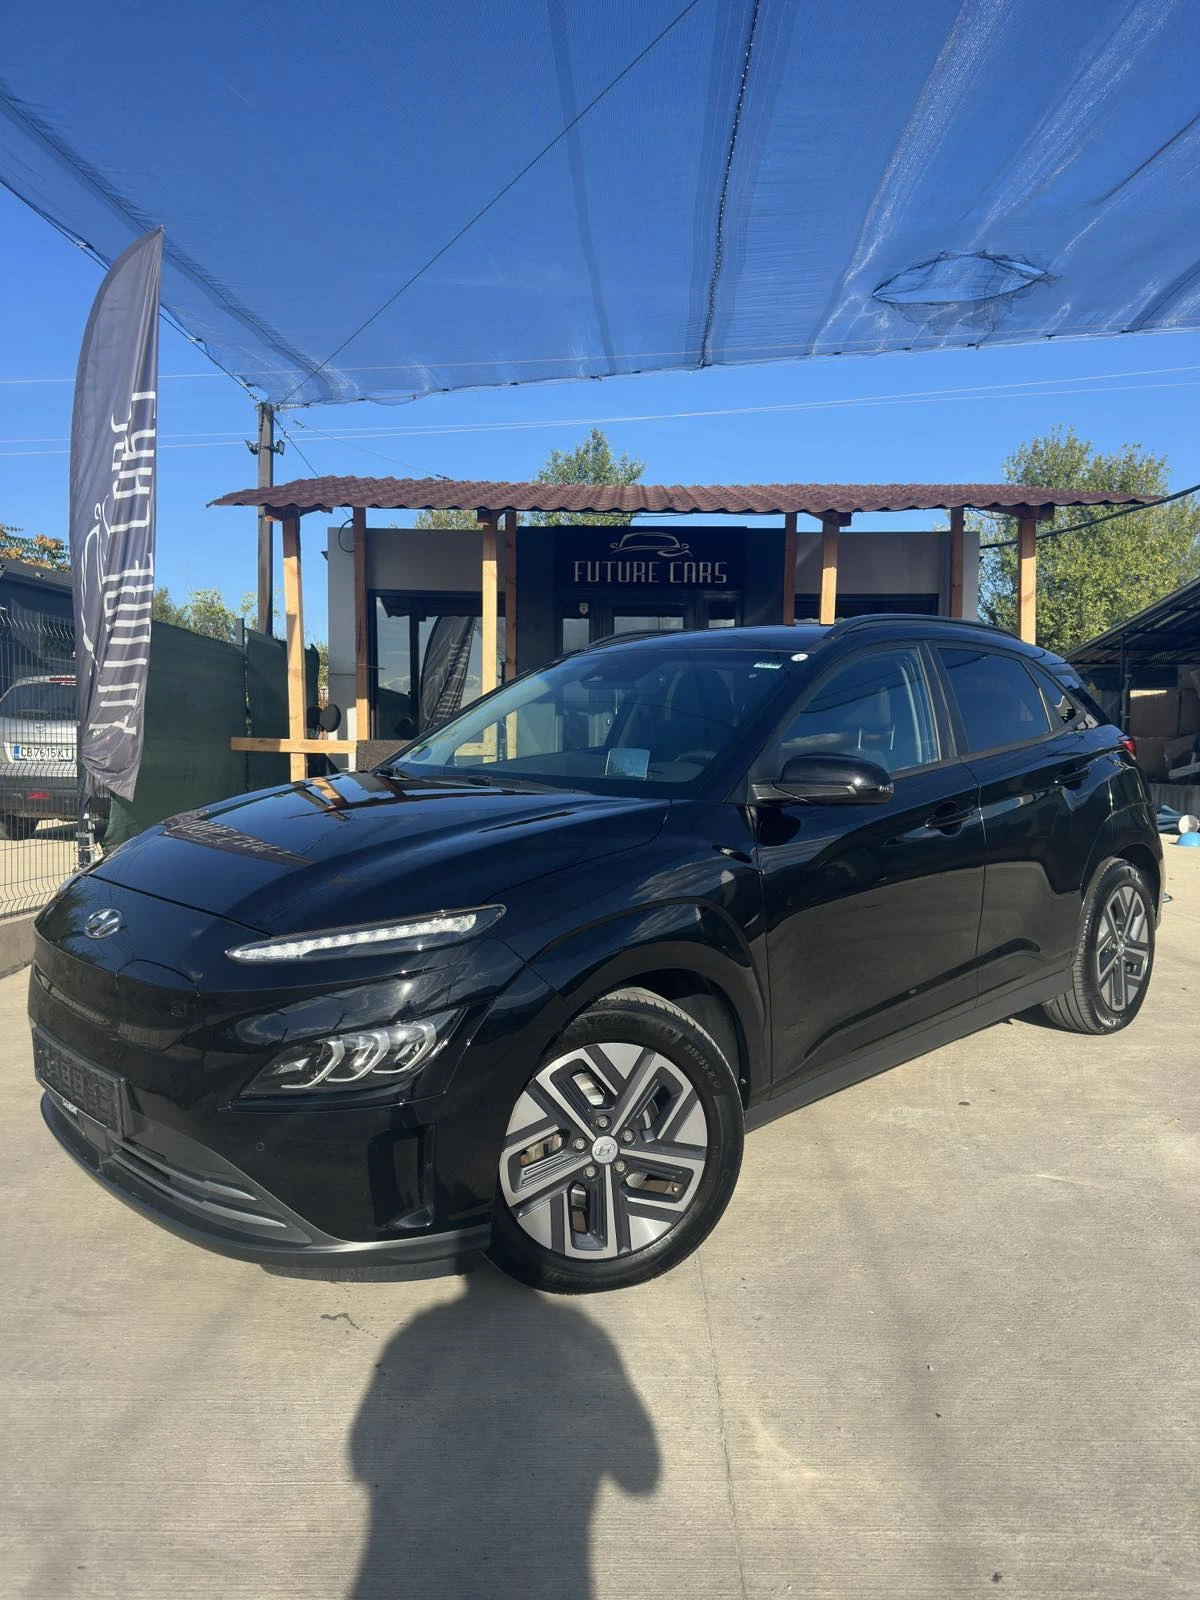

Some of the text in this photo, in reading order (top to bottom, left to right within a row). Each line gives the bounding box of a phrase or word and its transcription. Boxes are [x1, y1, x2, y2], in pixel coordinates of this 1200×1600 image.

[89, 391, 156, 736] FUTURE CARS
[573, 561, 728, 583] FUTURE CARS
